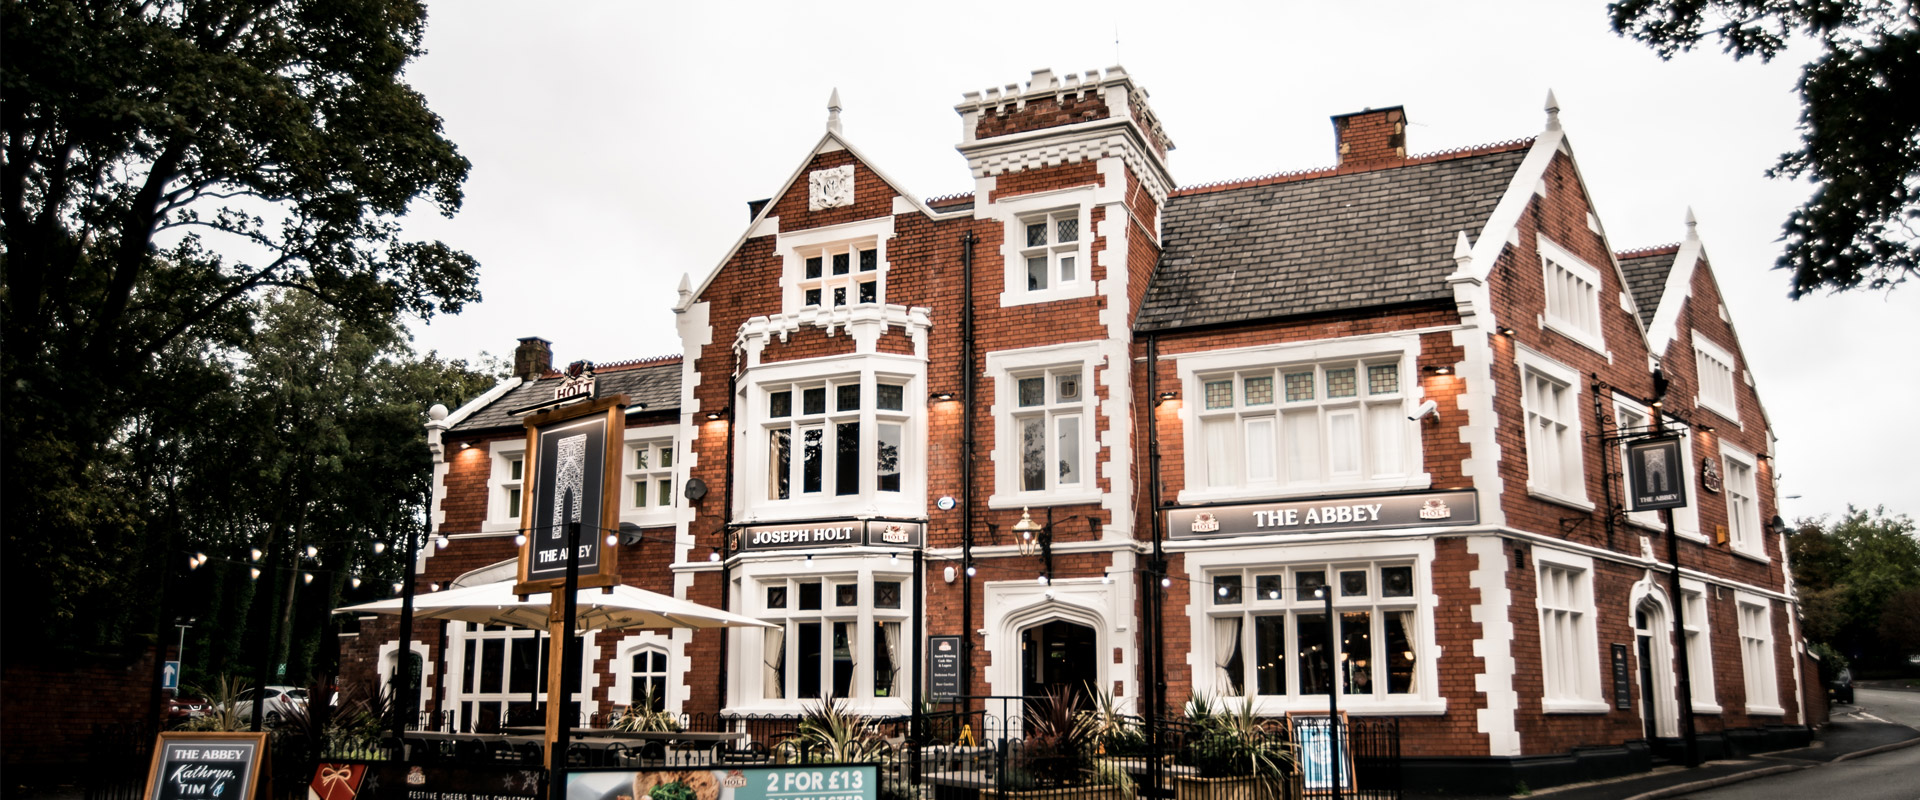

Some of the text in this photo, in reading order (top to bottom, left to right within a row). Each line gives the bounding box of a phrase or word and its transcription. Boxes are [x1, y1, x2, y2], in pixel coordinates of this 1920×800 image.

[557, 382, 592, 399] HOLT
[1253, 503, 1383, 527] THE ABBEY
[753, 526, 853, 545] JOSEPH HOLT
[539, 544, 592, 563] THE AEY
[175, 750, 244, 760] THE ABBEY
[170, 764, 236, 789] Kathryn,
[767, 770, 863, 791] 2 FOR £13
[180, 784, 206, 794] TIM
[408, 791, 437, 800] FESTIVE
